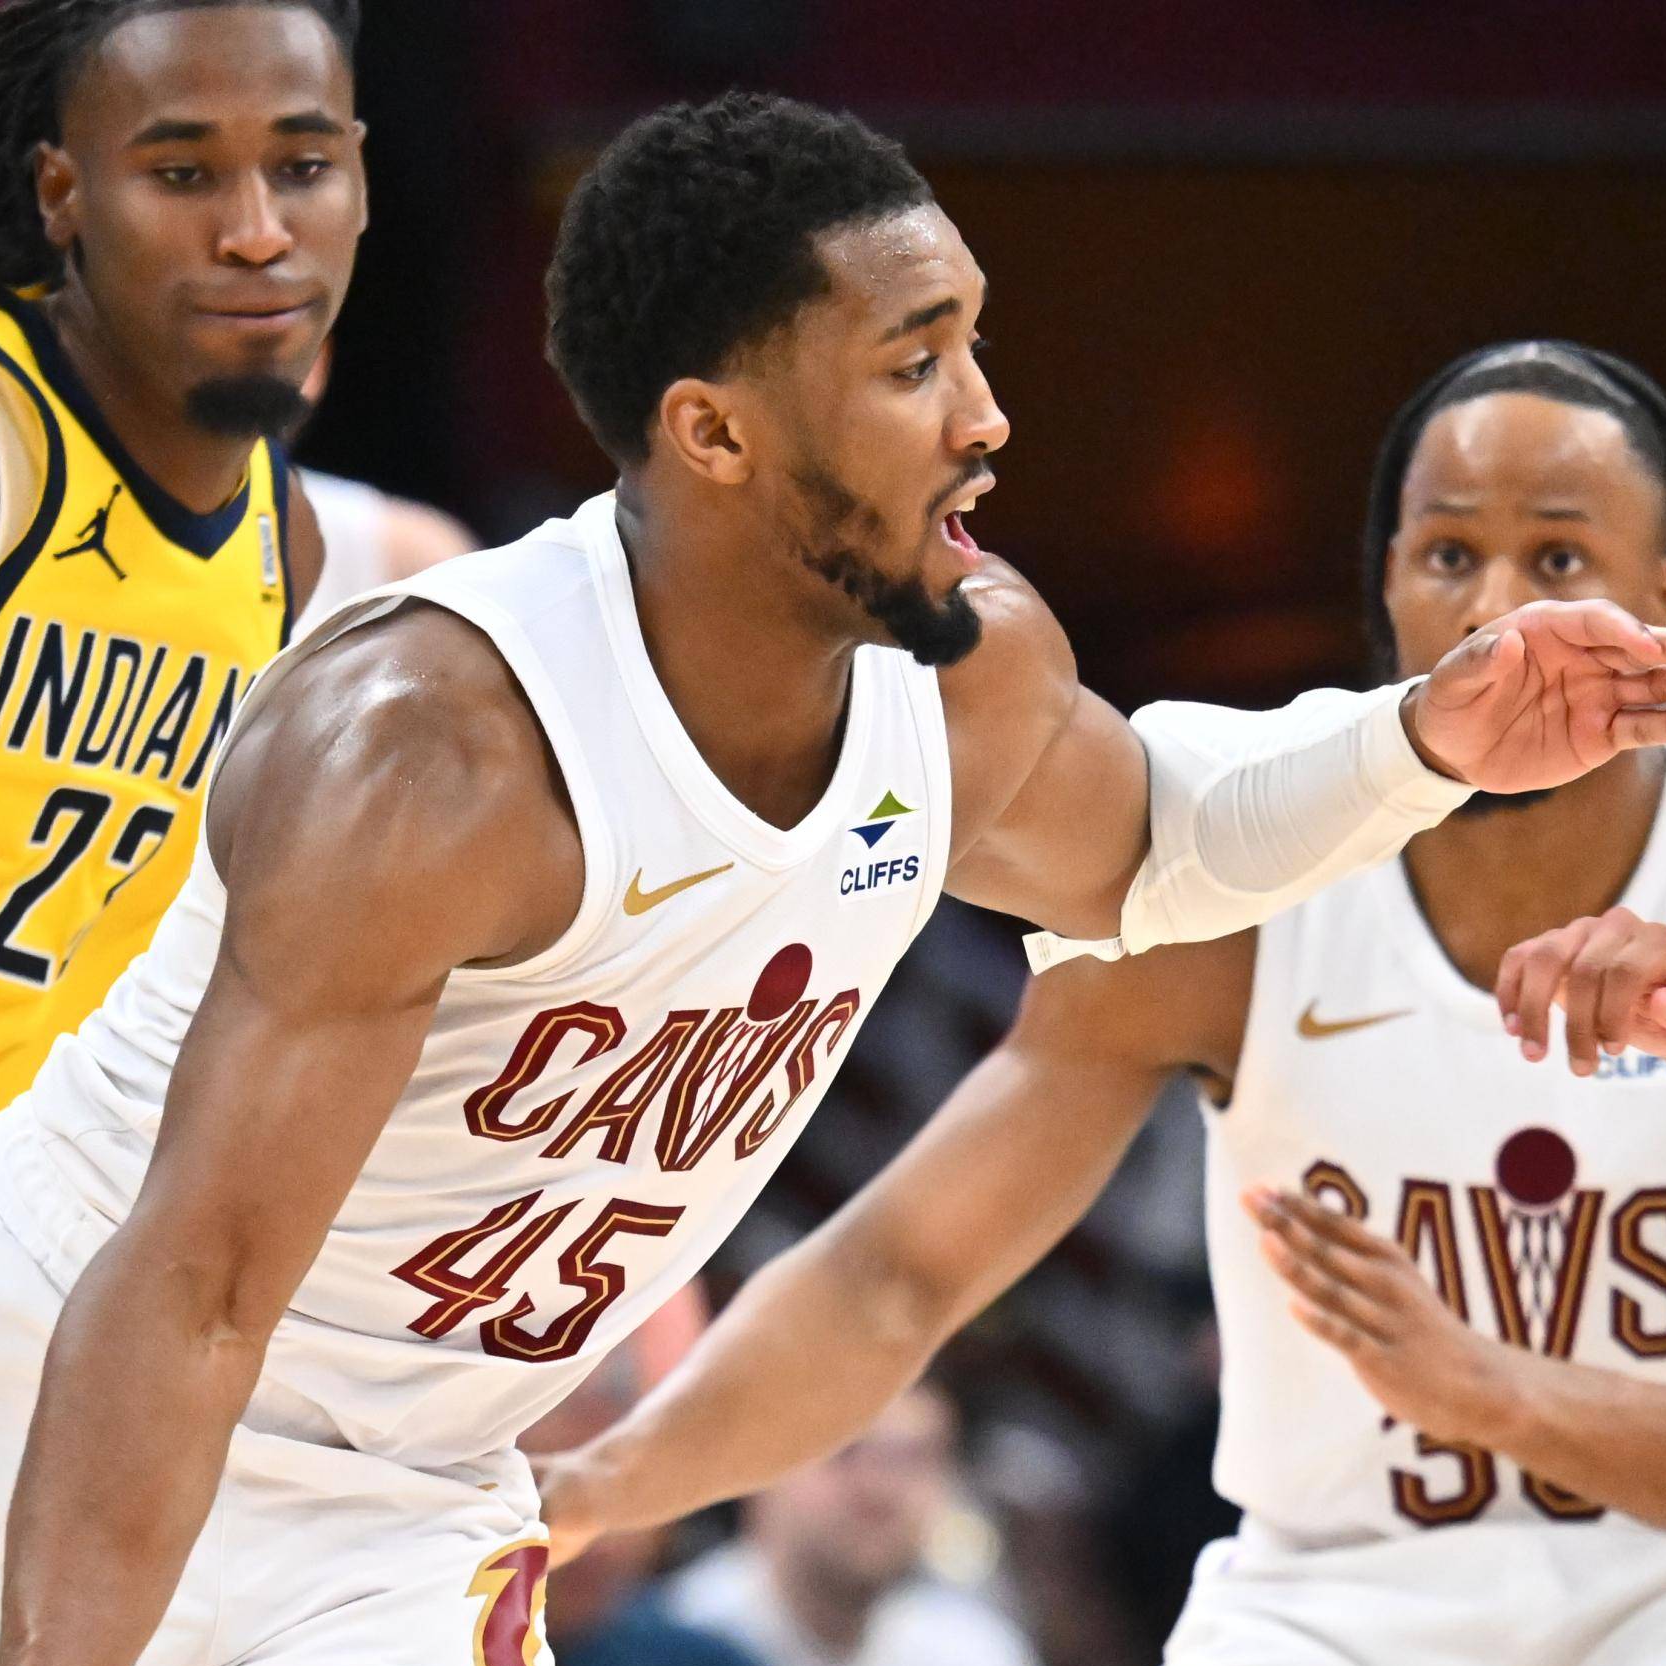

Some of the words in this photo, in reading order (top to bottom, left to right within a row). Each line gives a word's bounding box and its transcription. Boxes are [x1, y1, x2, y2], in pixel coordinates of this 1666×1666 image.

[840, 855, 919, 896] CLIFFS
[463, 987, 861, 1173] CAVS
[389, 1189, 687, 1364] 45
